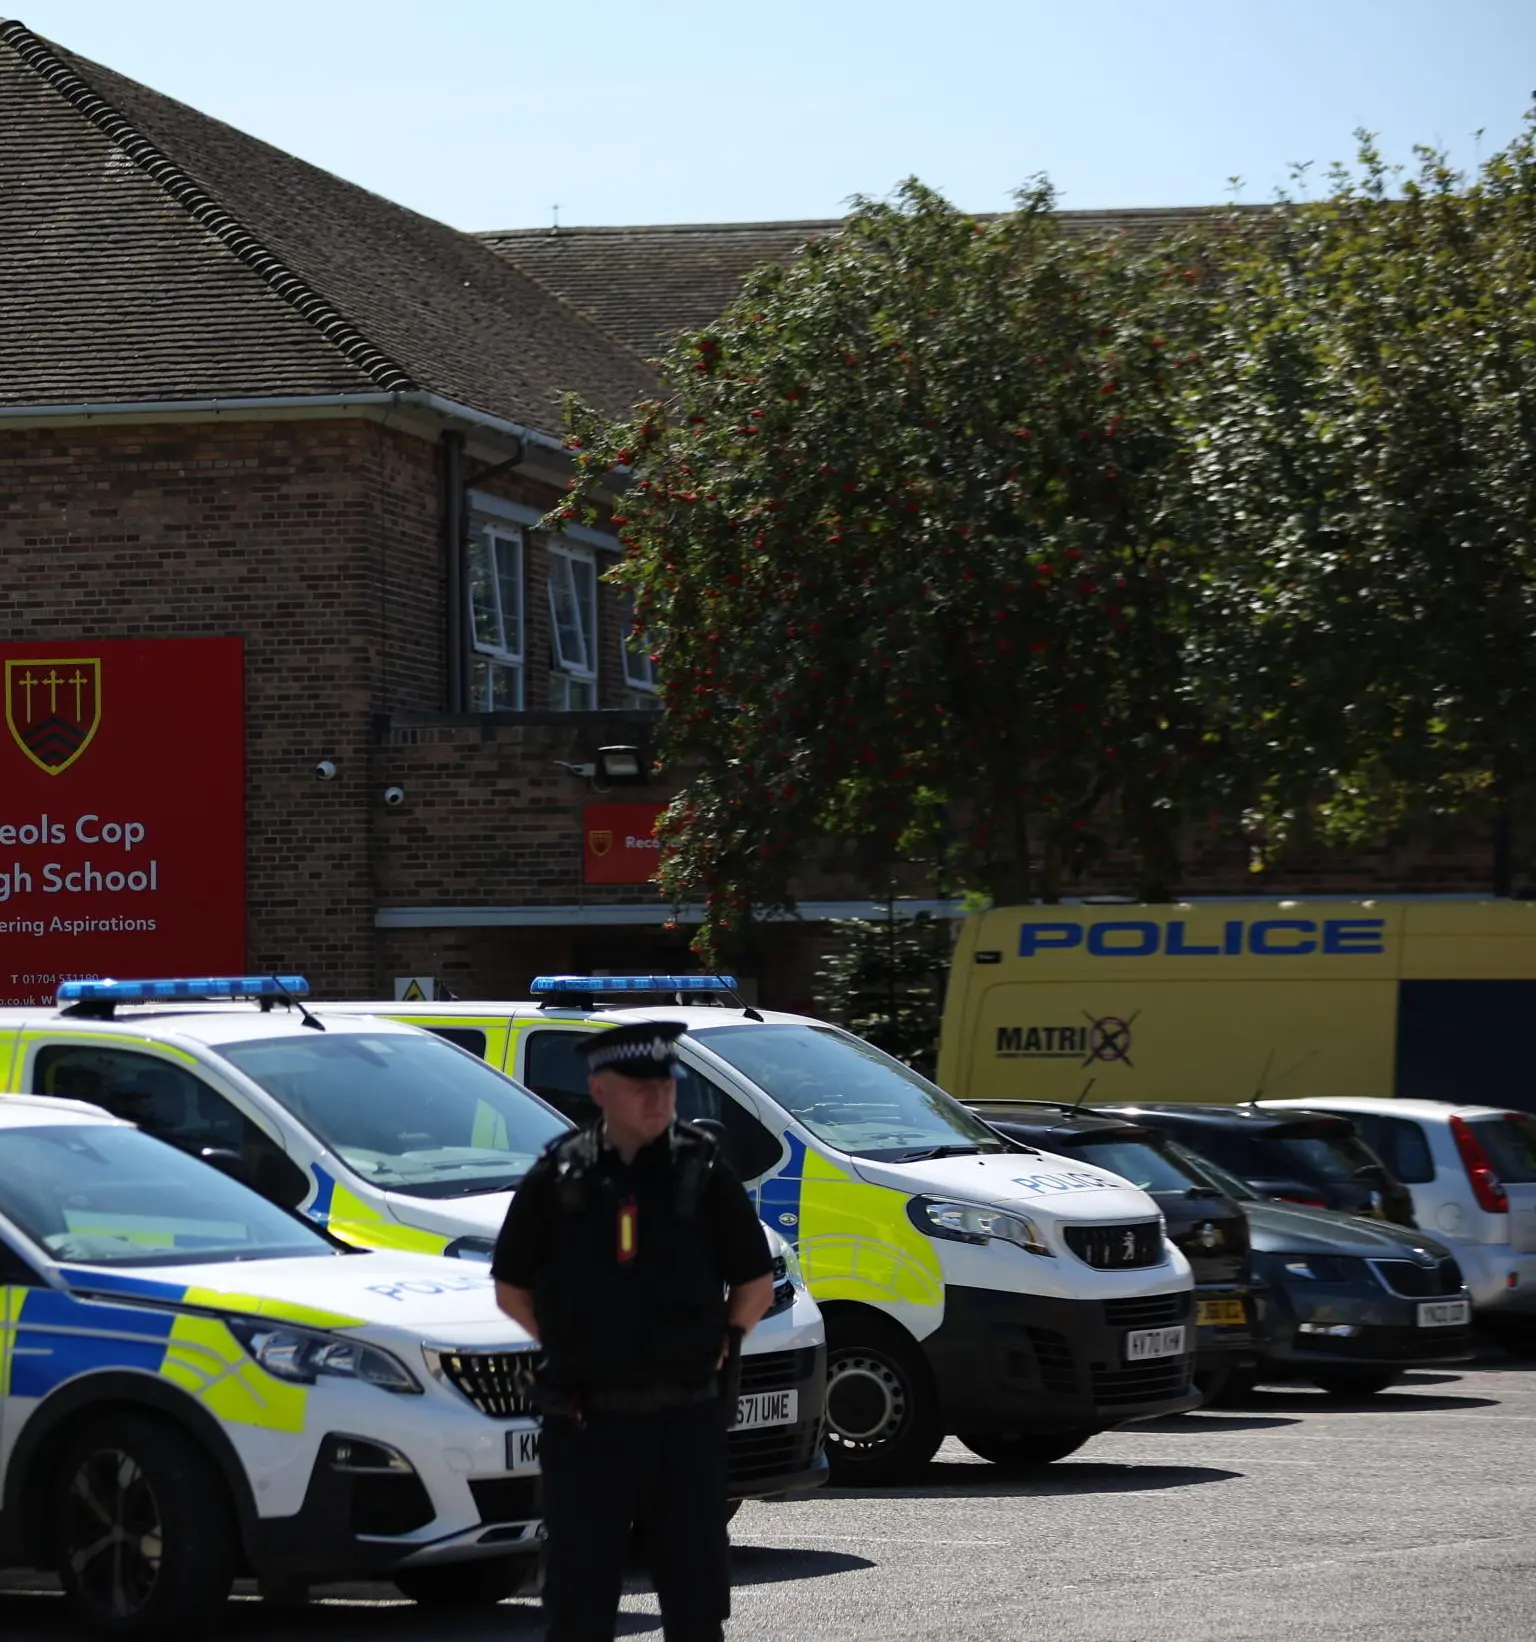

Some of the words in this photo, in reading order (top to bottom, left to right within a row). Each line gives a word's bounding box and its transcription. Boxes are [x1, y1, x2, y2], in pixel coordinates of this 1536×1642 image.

[75, 814, 145, 851] Cop
[42, 860, 158, 892] School
[49, 915, 157, 936] Aspirations
[1018, 919, 1385, 957] POLICE
[11, 974, 19, 984] T
[22, 974, 56, 984] 01704
[41, 995, 52, 1005] W
[1011, 1172, 1121, 1194] POLICE
[736, 1397, 758, 1424] S71
[761, 1394, 789, 1420] UME
[520, 1432, 541, 1463] KM
